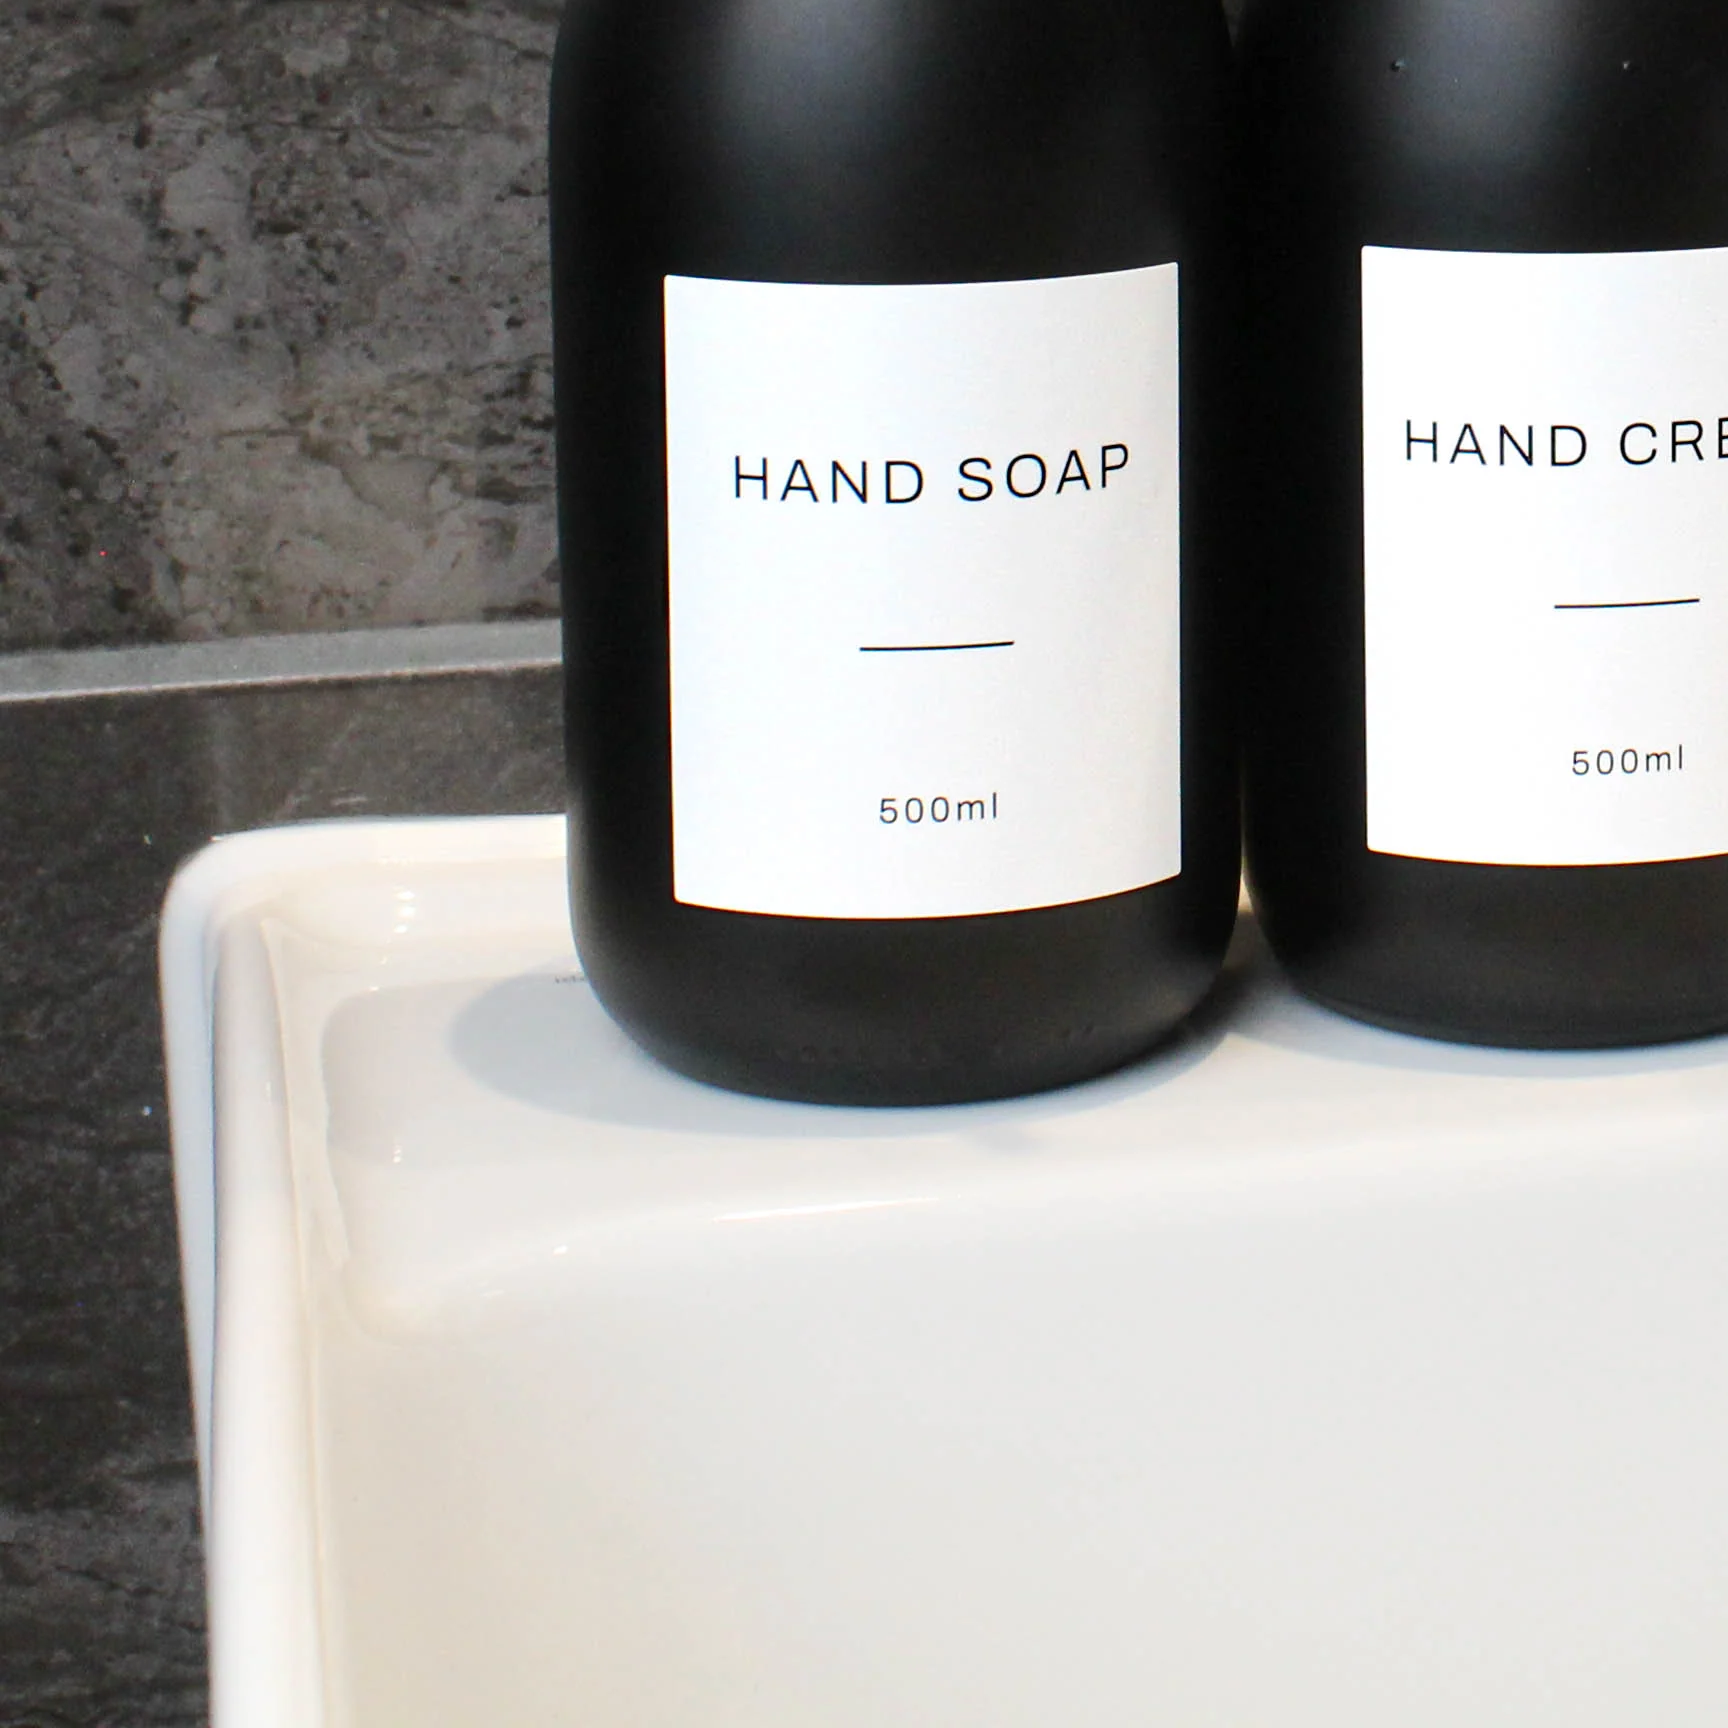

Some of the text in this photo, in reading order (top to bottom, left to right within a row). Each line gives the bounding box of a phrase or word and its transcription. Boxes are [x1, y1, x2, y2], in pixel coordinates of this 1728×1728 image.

[1406, 419, 1588, 467] HAND
[734, 443, 1129, 504] HAND SOAP
[1572, 744, 1684, 776] 500ml
[879, 792, 998, 824] 500ml
